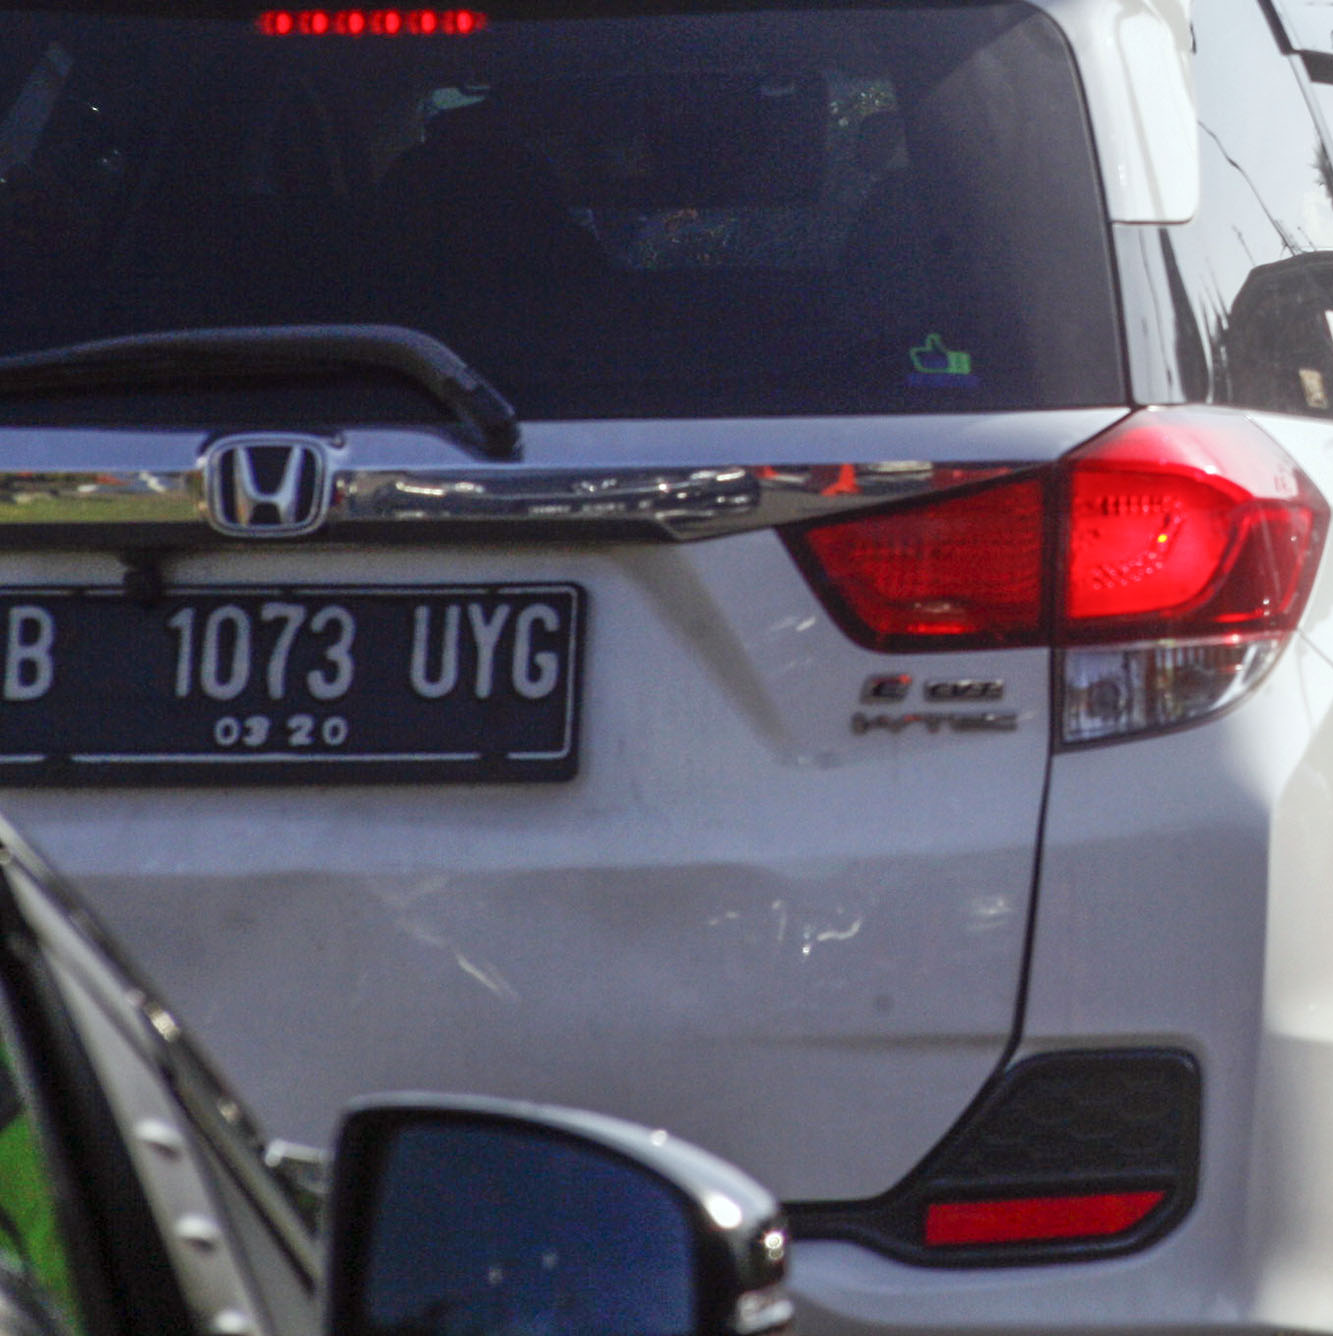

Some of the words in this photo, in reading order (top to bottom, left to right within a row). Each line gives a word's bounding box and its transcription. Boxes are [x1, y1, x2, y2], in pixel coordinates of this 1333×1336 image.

[3, 605, 55, 701] B
[166, 603, 356, 700] 1073
[409, 603, 560, 700] UYG
[214, 715, 272, 747] 03
[287, 714, 348, 747] 20
